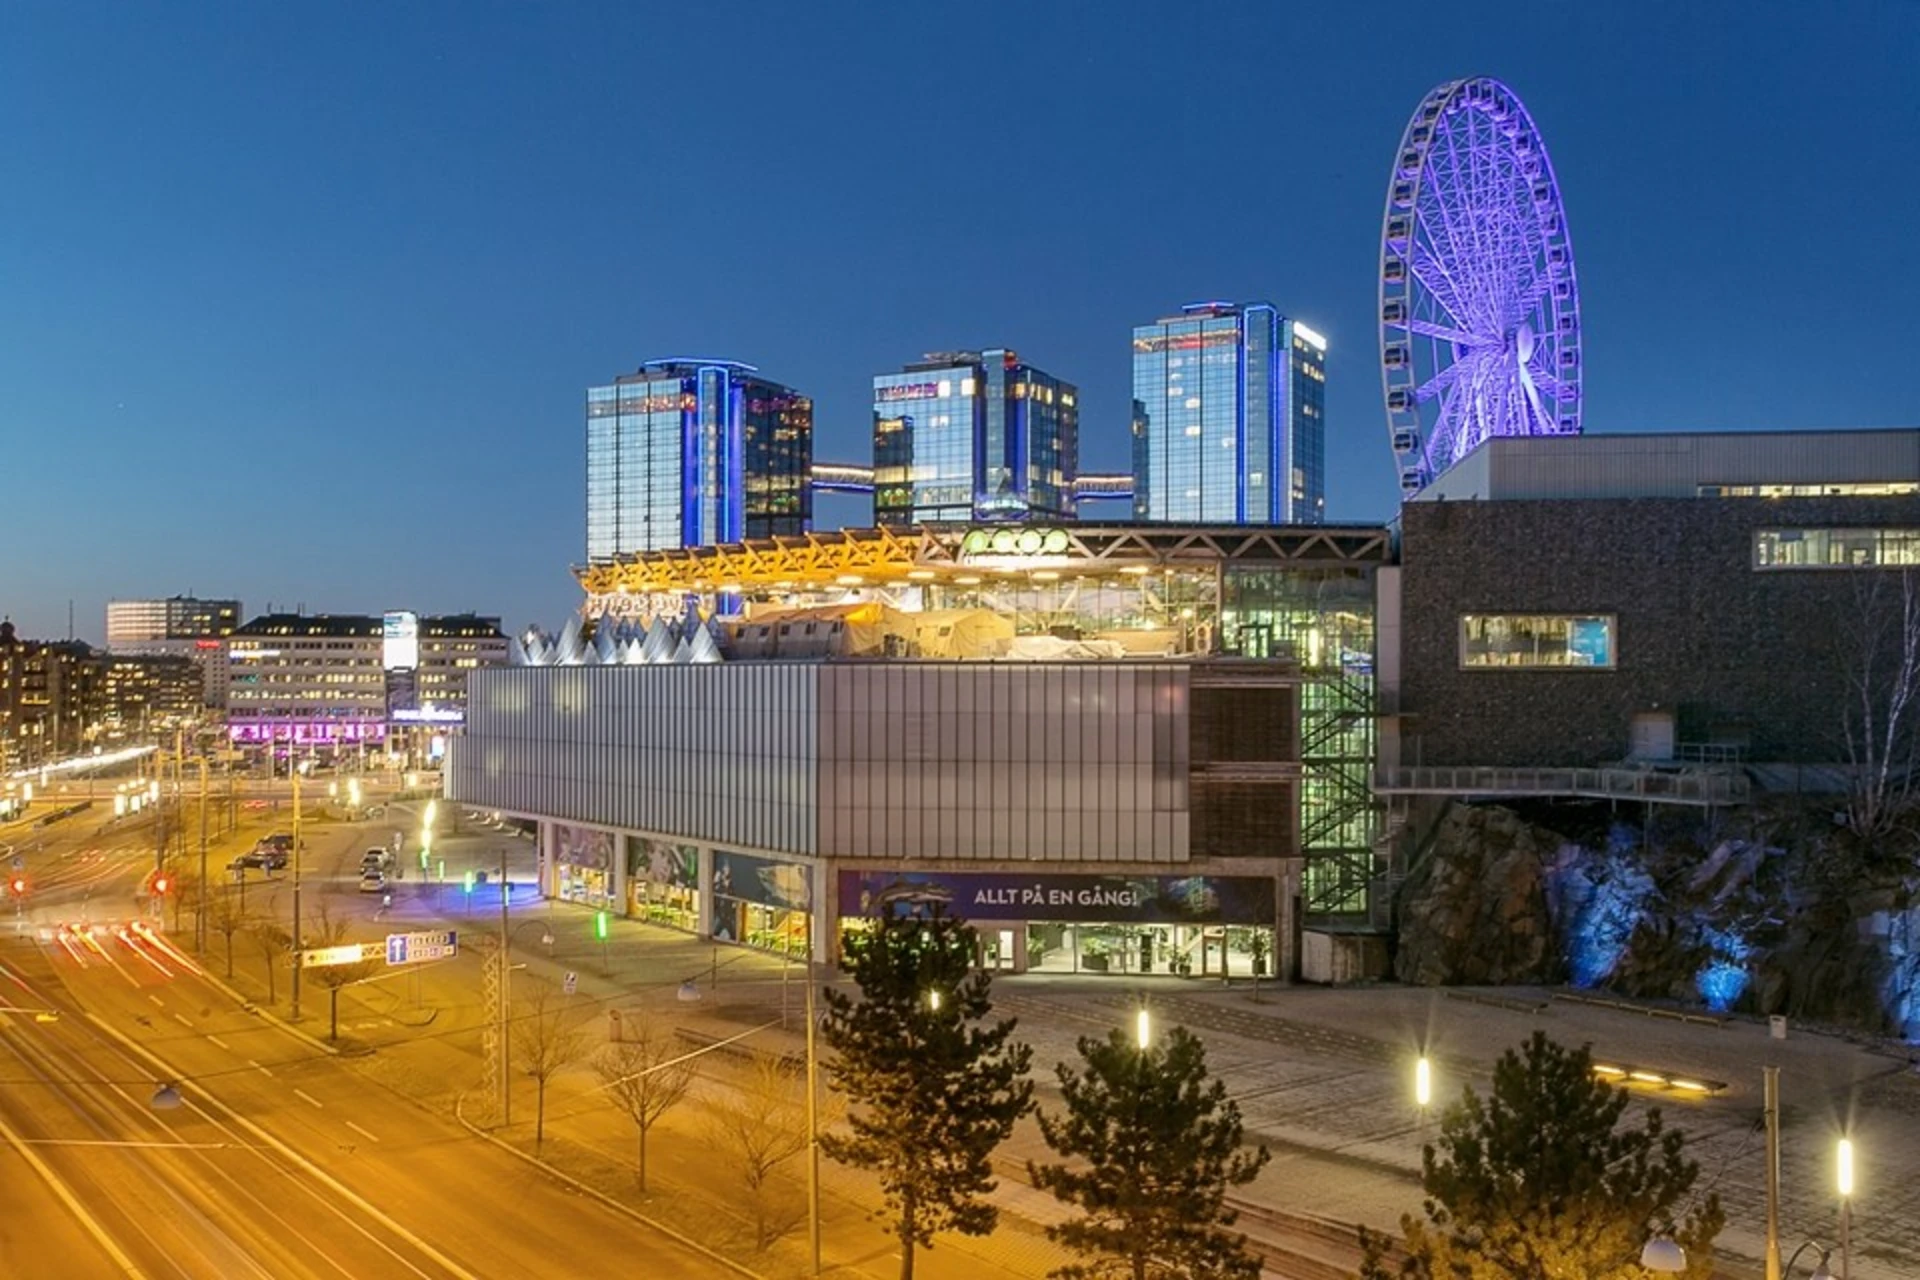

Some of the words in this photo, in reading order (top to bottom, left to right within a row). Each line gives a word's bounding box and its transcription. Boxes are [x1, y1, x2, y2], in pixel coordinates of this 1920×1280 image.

[974, 889, 1018, 904] ALLT
[1022, 884, 1045, 904] PÅ
[1049, 889, 1074, 904] EN
[1078, 885, 1137, 906] GÅNG!
